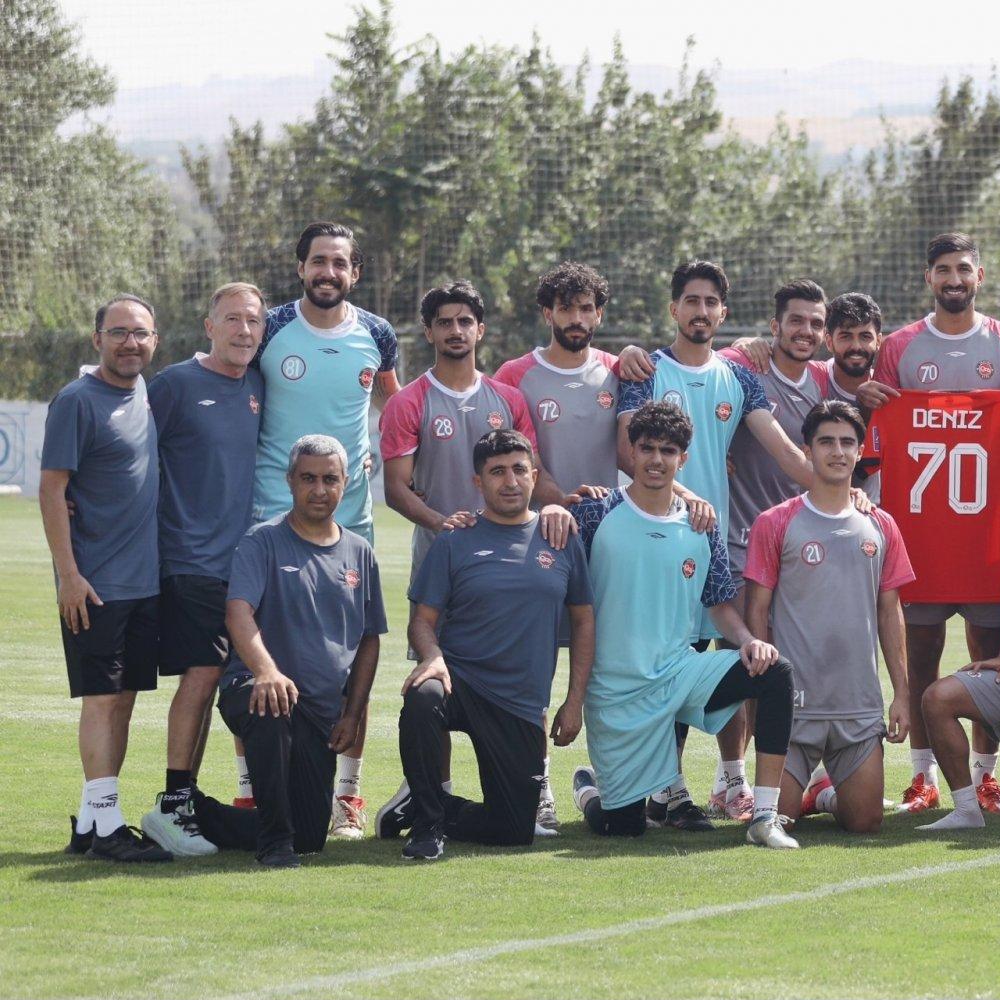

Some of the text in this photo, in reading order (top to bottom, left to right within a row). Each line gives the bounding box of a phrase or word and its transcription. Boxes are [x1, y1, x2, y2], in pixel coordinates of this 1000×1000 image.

[920, 365, 938, 383] 70
[539, 402, 559, 421] 72
[912, 408, 983, 430] DENIZ
[434, 418, 453, 437] 28
[907, 442, 988, 515] 70
[806, 545, 821, 562] 21
